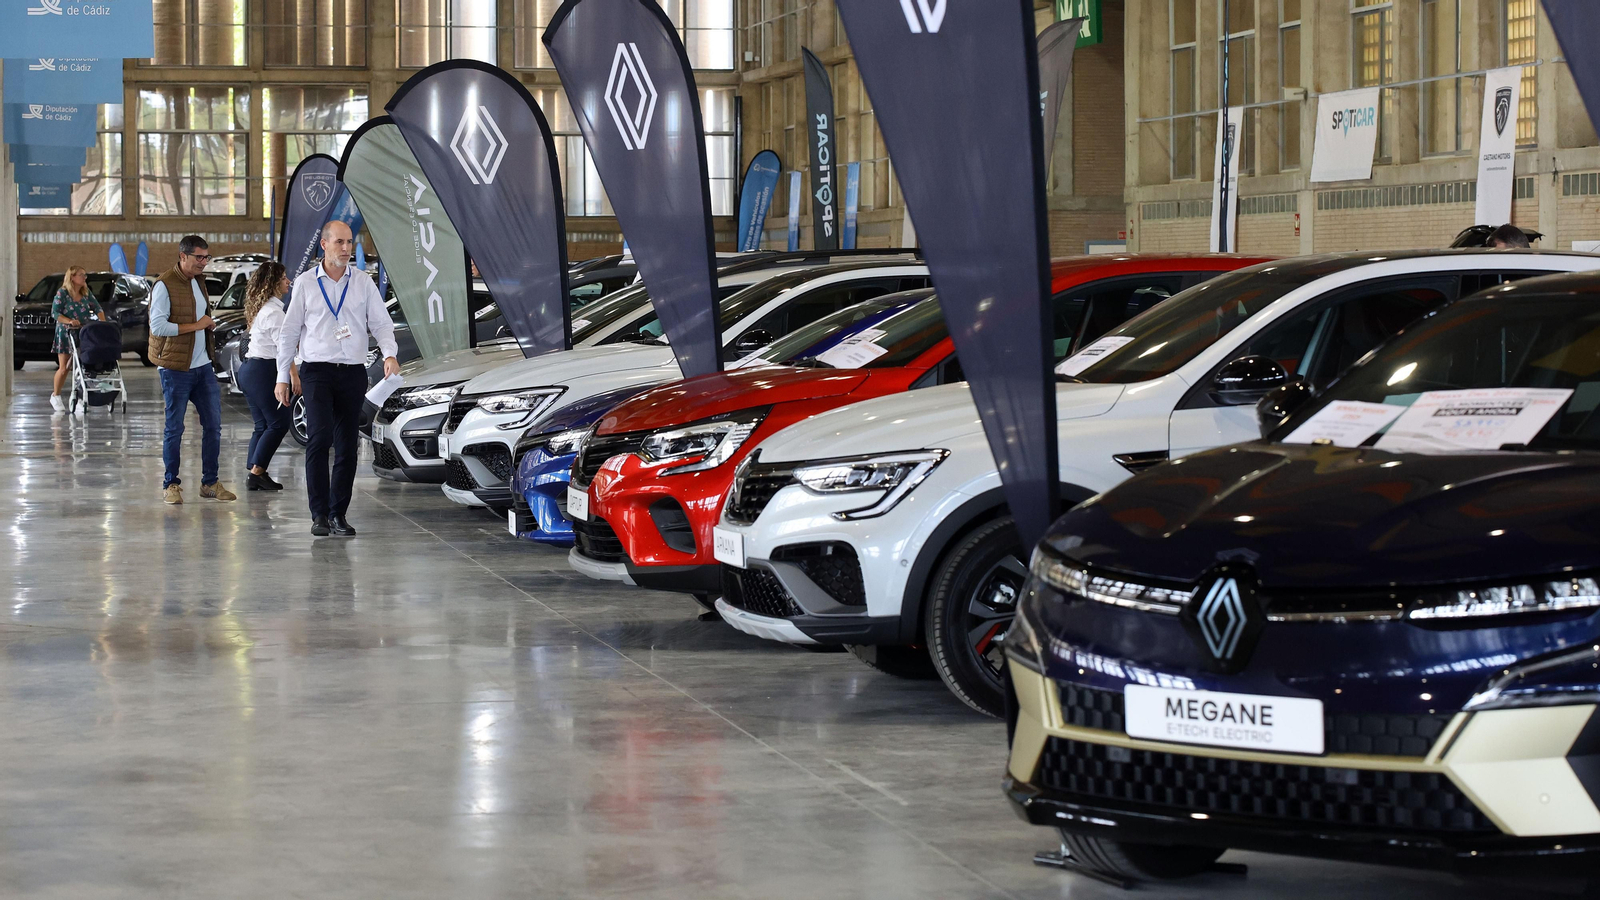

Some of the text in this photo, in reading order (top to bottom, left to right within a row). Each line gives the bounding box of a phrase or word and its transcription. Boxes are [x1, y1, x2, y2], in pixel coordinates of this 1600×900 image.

[67, 5, 110, 15] de Cádiz
[46, 105, 78, 113] Diputación
[304, 228, 321, 256] Motors
[1166, 698, 1273, 726] MEGANE
[1166, 722, 1273, 744] E-TECH ELECTRIC
